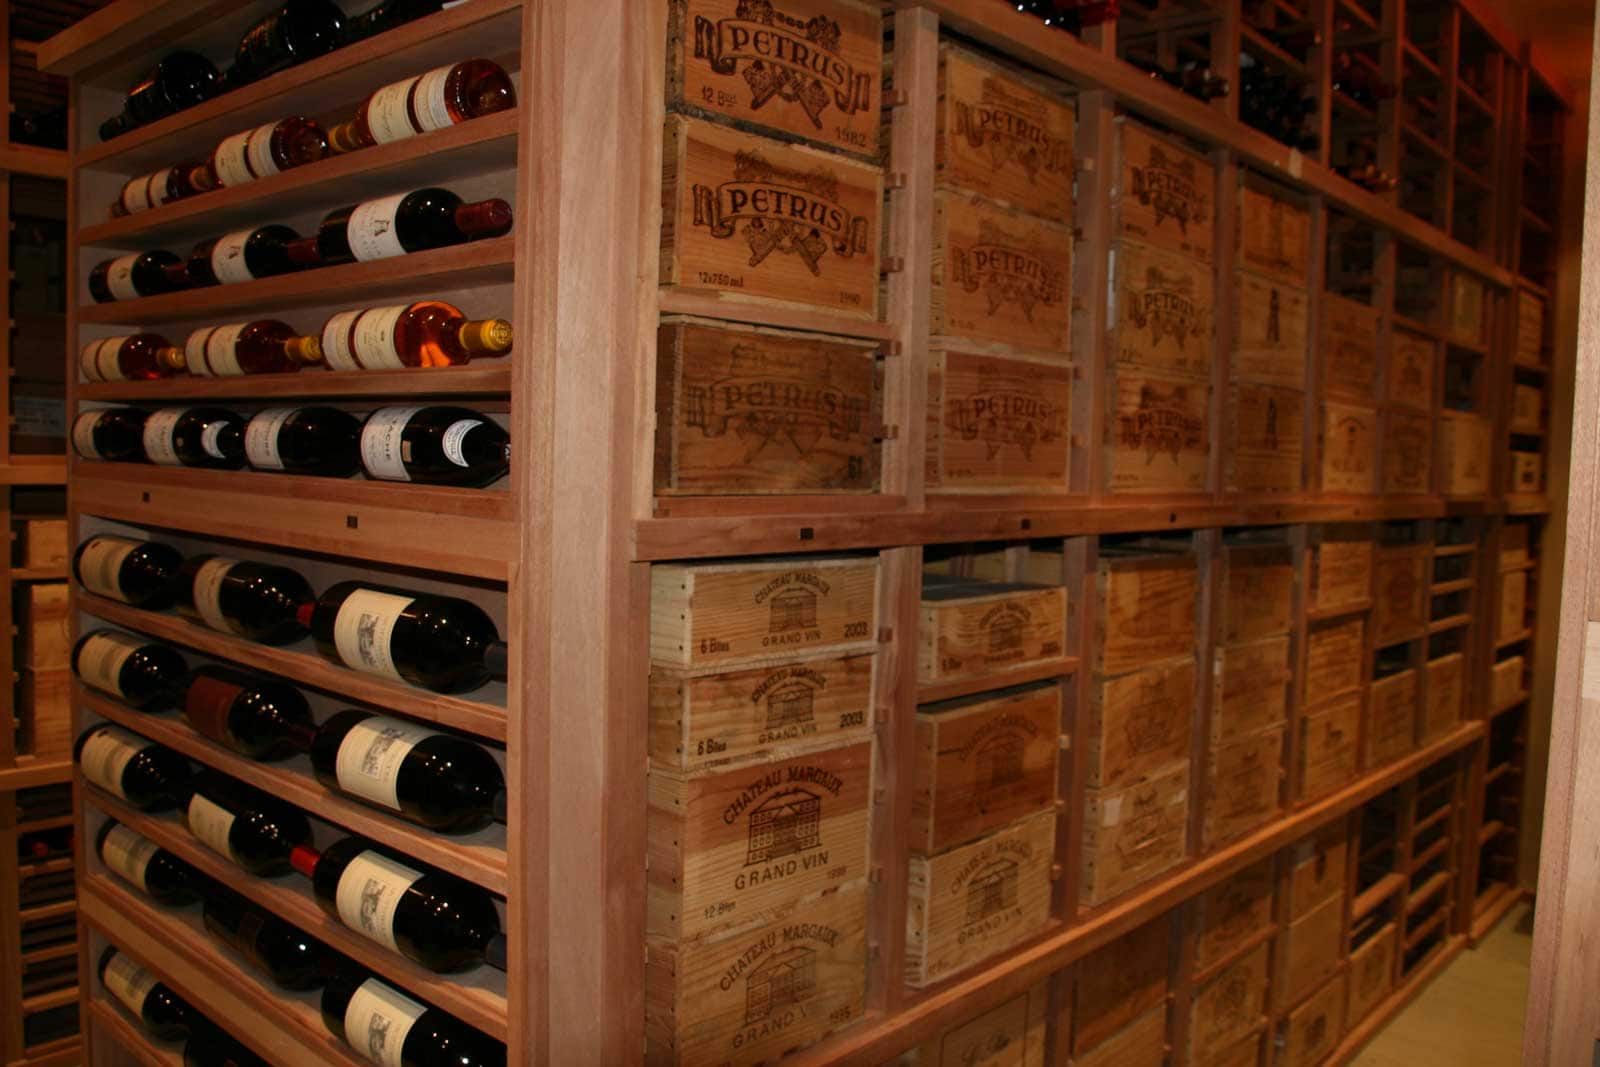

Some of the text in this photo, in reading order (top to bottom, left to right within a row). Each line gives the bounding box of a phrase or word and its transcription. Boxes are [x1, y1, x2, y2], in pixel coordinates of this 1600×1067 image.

[729, 24, 845, 86] PETRUS
[702, 85, 713, 103] 12
[979, 108, 1050, 151] PETRUS
[726, 188, 843, 232] PETRUS
[973, 249, 1049, 285] PETRUS
[973, 396, 1049, 422] PETRUS
[701, 639, 707, 654] 6
[762, 629, 822, 647] GRAND VIN
[697, 741, 704, 756] 6
[758, 726, 798, 744] GRAND
[722, 769, 782, 825] CHATEAU
[734, 859, 798, 891] GRAND
[802, 850, 830, 871] VIN
[719, 932, 777, 992] CHATEAU
[732, 1013, 795, 1049] GRAND
